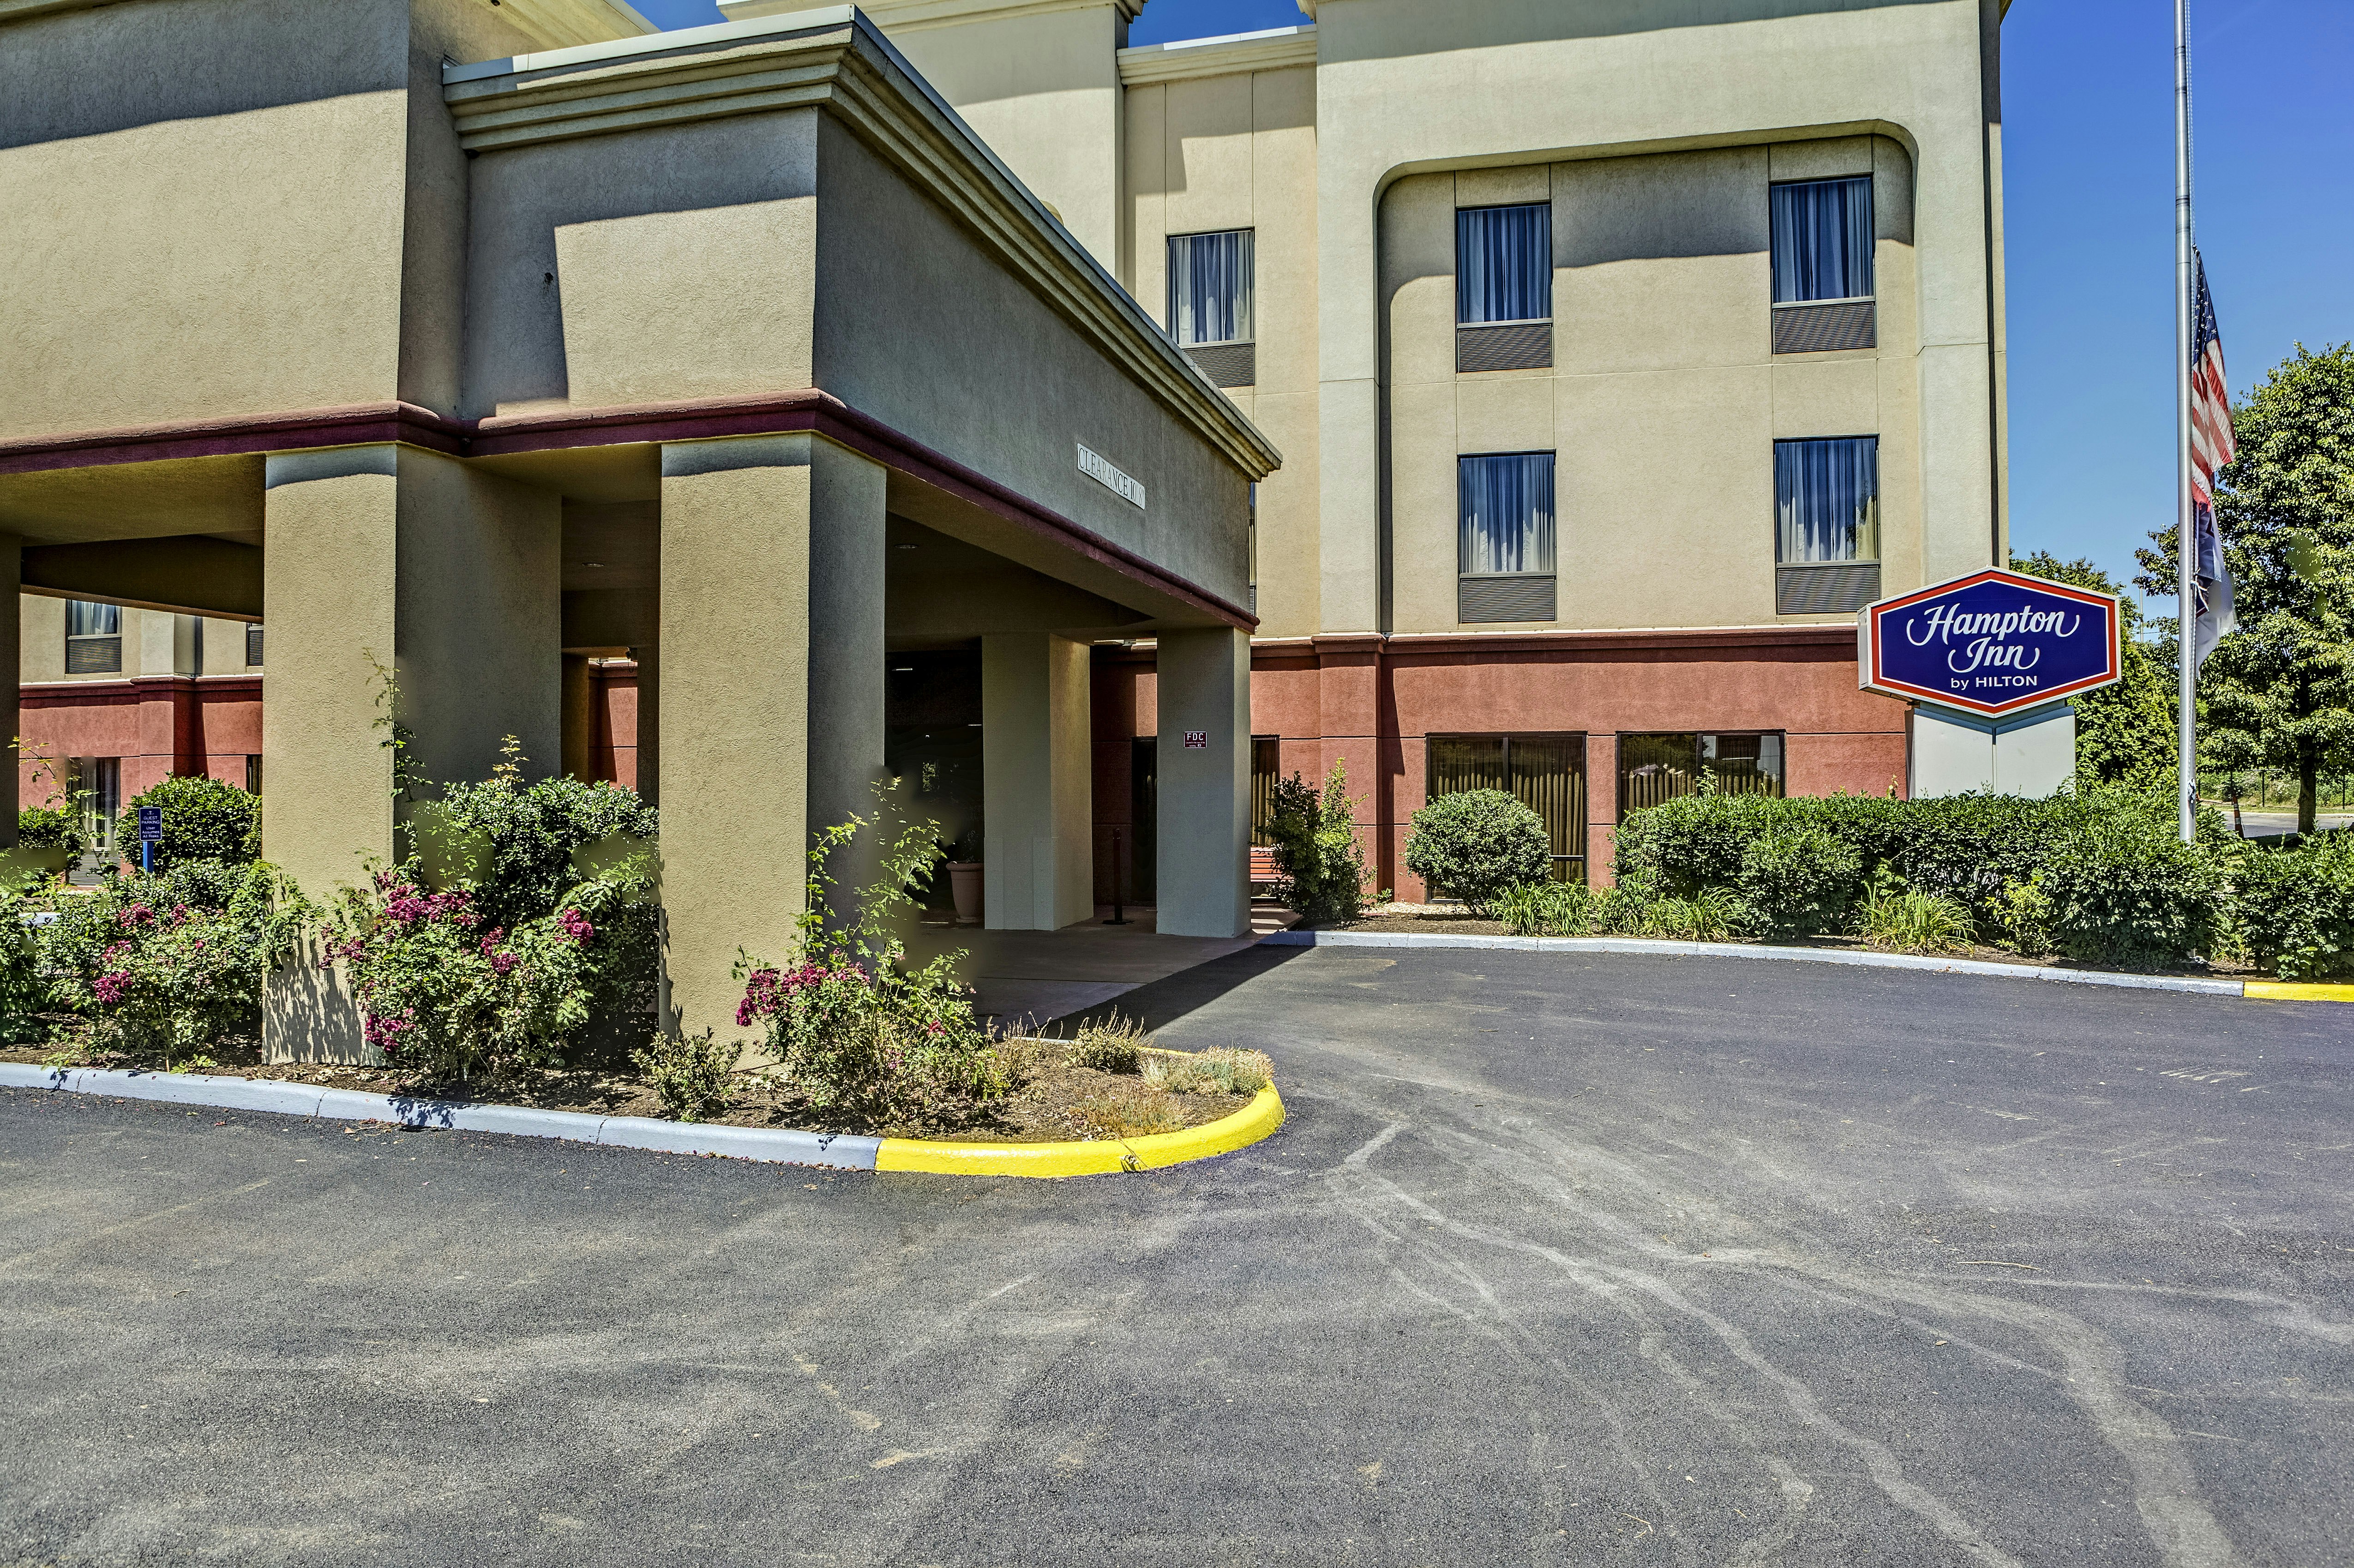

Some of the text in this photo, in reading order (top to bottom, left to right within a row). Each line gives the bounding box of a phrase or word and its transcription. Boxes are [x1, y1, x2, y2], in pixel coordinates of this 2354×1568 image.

[1079, 448, 1128, 497] CLEARANCE
[1906, 603, 2080, 646] Hampton
[1948, 637, 2040, 673] Inn
[1951, 676, 2037, 690] by HILTON
